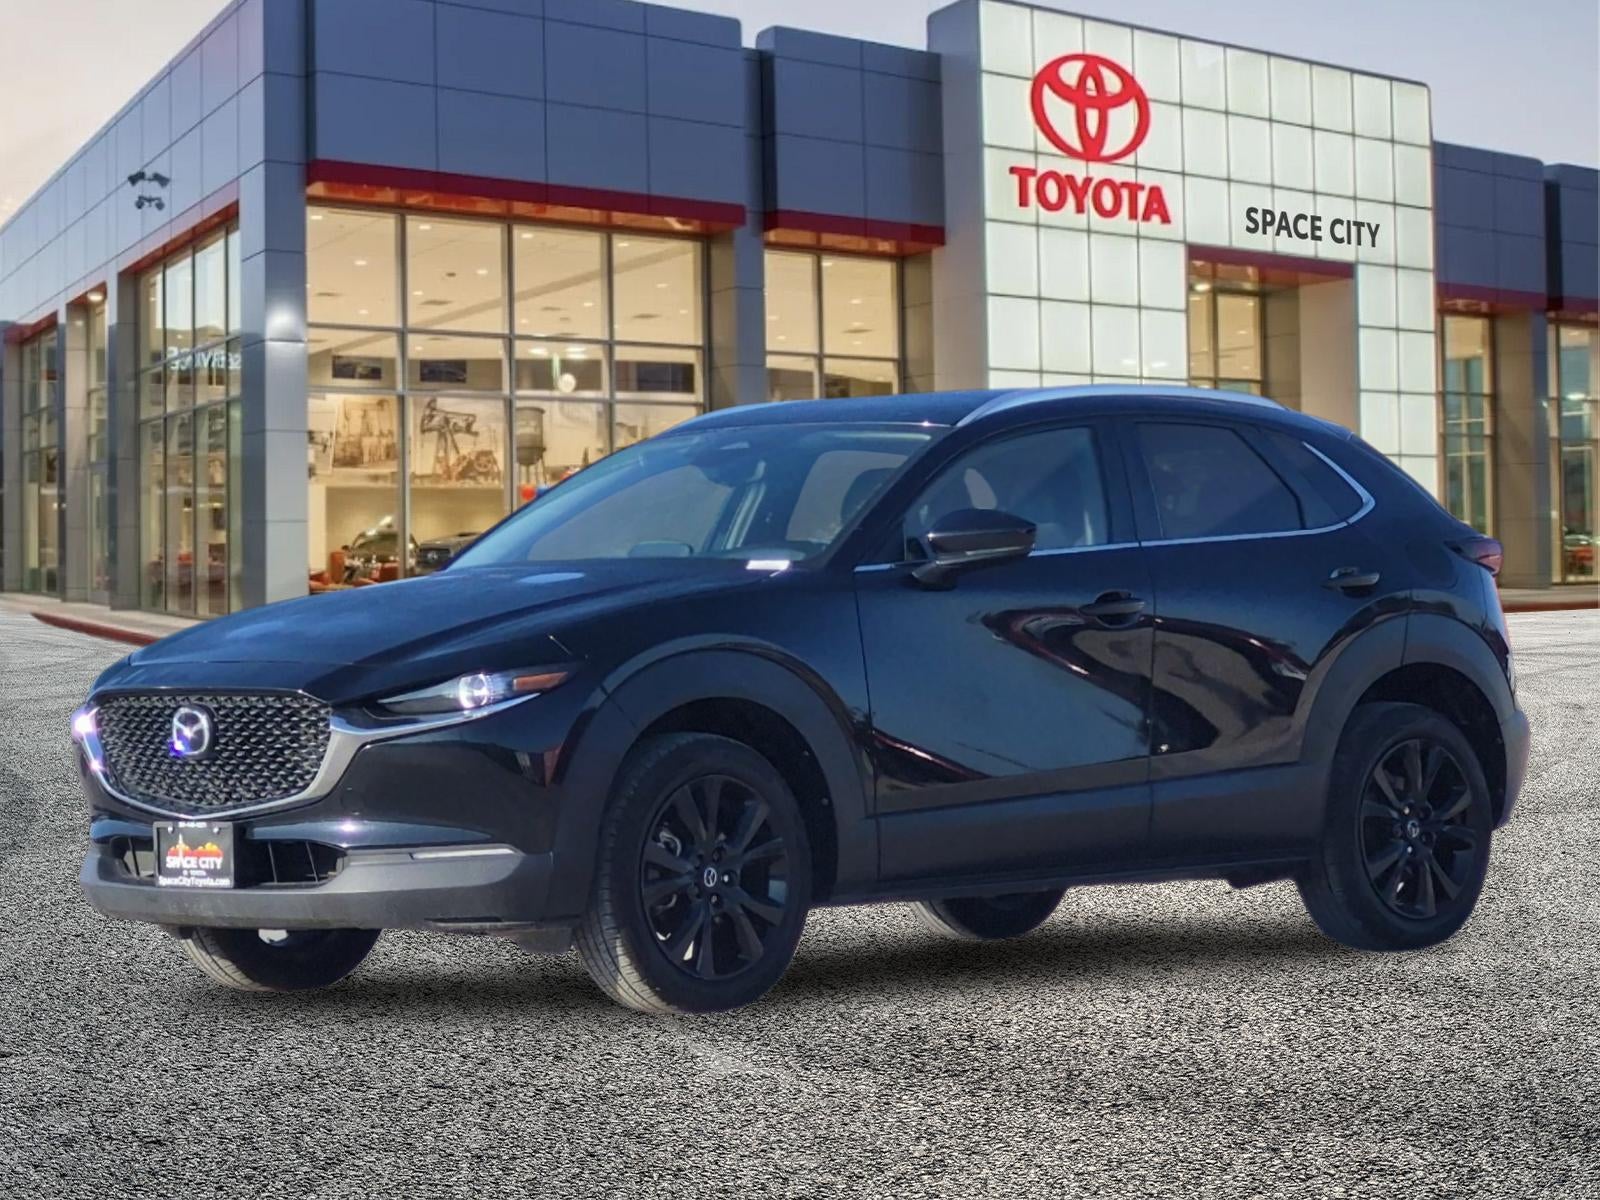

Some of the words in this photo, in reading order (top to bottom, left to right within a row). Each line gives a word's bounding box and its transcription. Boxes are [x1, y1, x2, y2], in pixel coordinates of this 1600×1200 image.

[1009, 166, 1171, 224] TOYOTA
[1245, 206, 1322, 242] SPACE
[1329, 217, 1381, 248] CITY
[166, 856, 198, 868] SPACE
[199, 857, 223, 869] CITY
[159, 876, 231, 887] SpaceCityToyota.com
